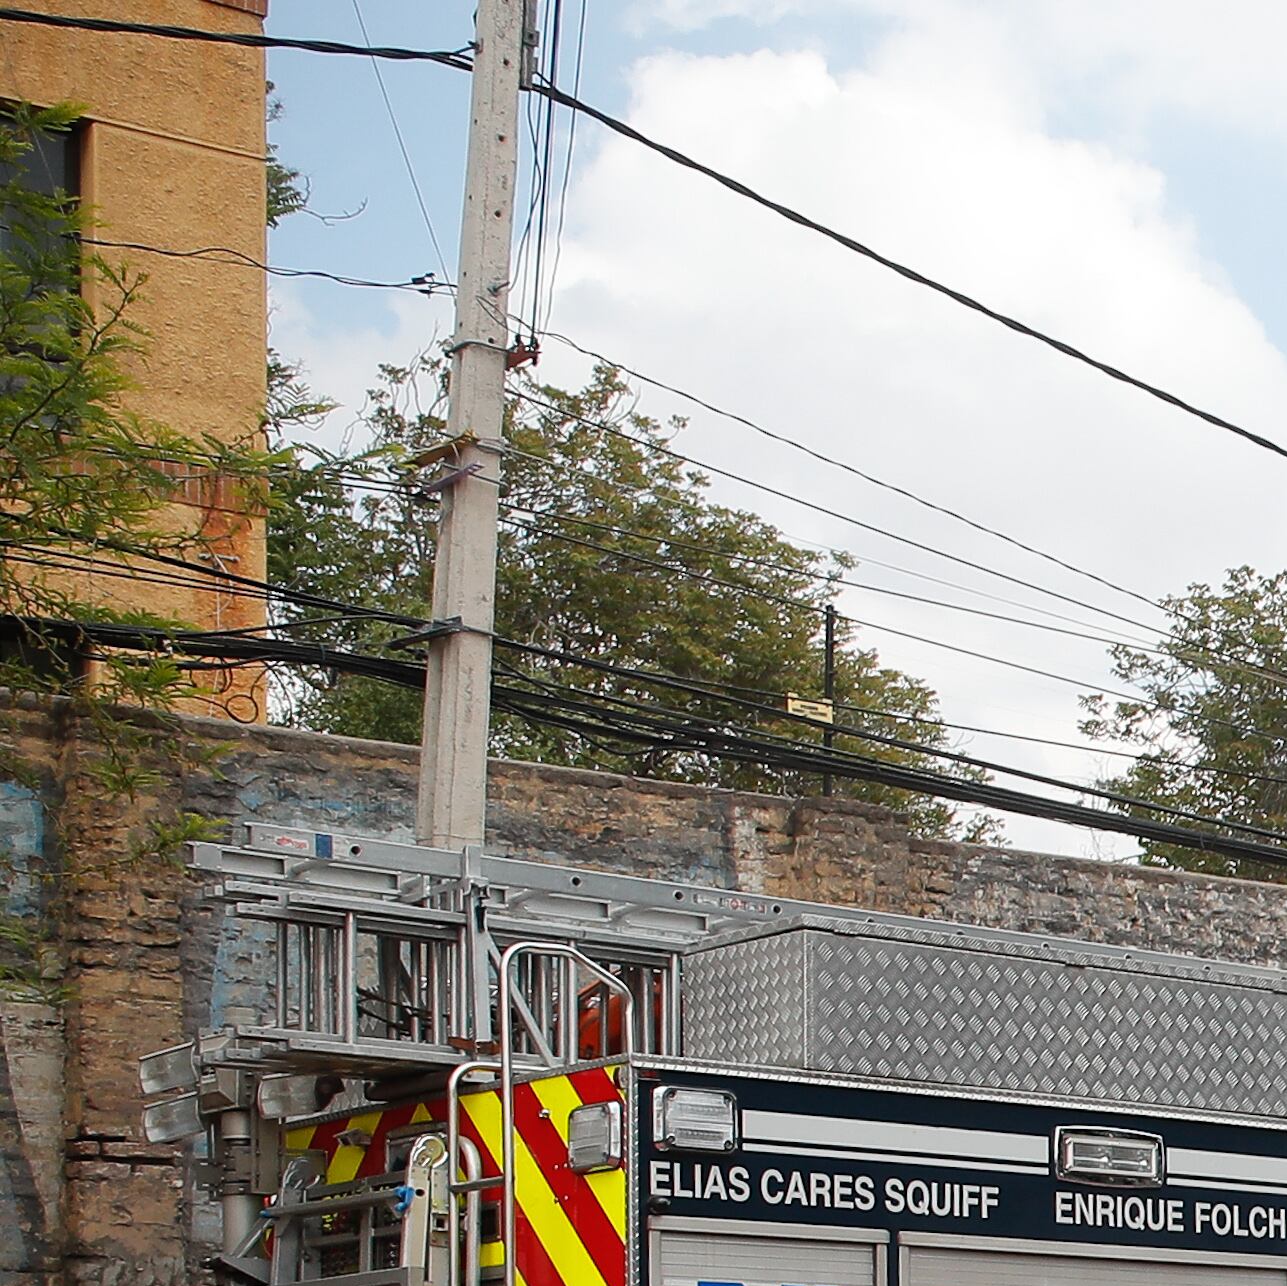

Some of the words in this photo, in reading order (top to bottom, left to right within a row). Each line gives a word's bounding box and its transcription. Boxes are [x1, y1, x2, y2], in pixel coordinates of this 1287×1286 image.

[650, 1160, 750, 1202] ELIAS
[760, 1169, 875, 1210] CARES
[885, 1178, 999, 1219] SQUIFF
[1055, 1191, 1184, 1232] ENRIQUE
[1195, 1202, 1286, 1240] FOLCH
